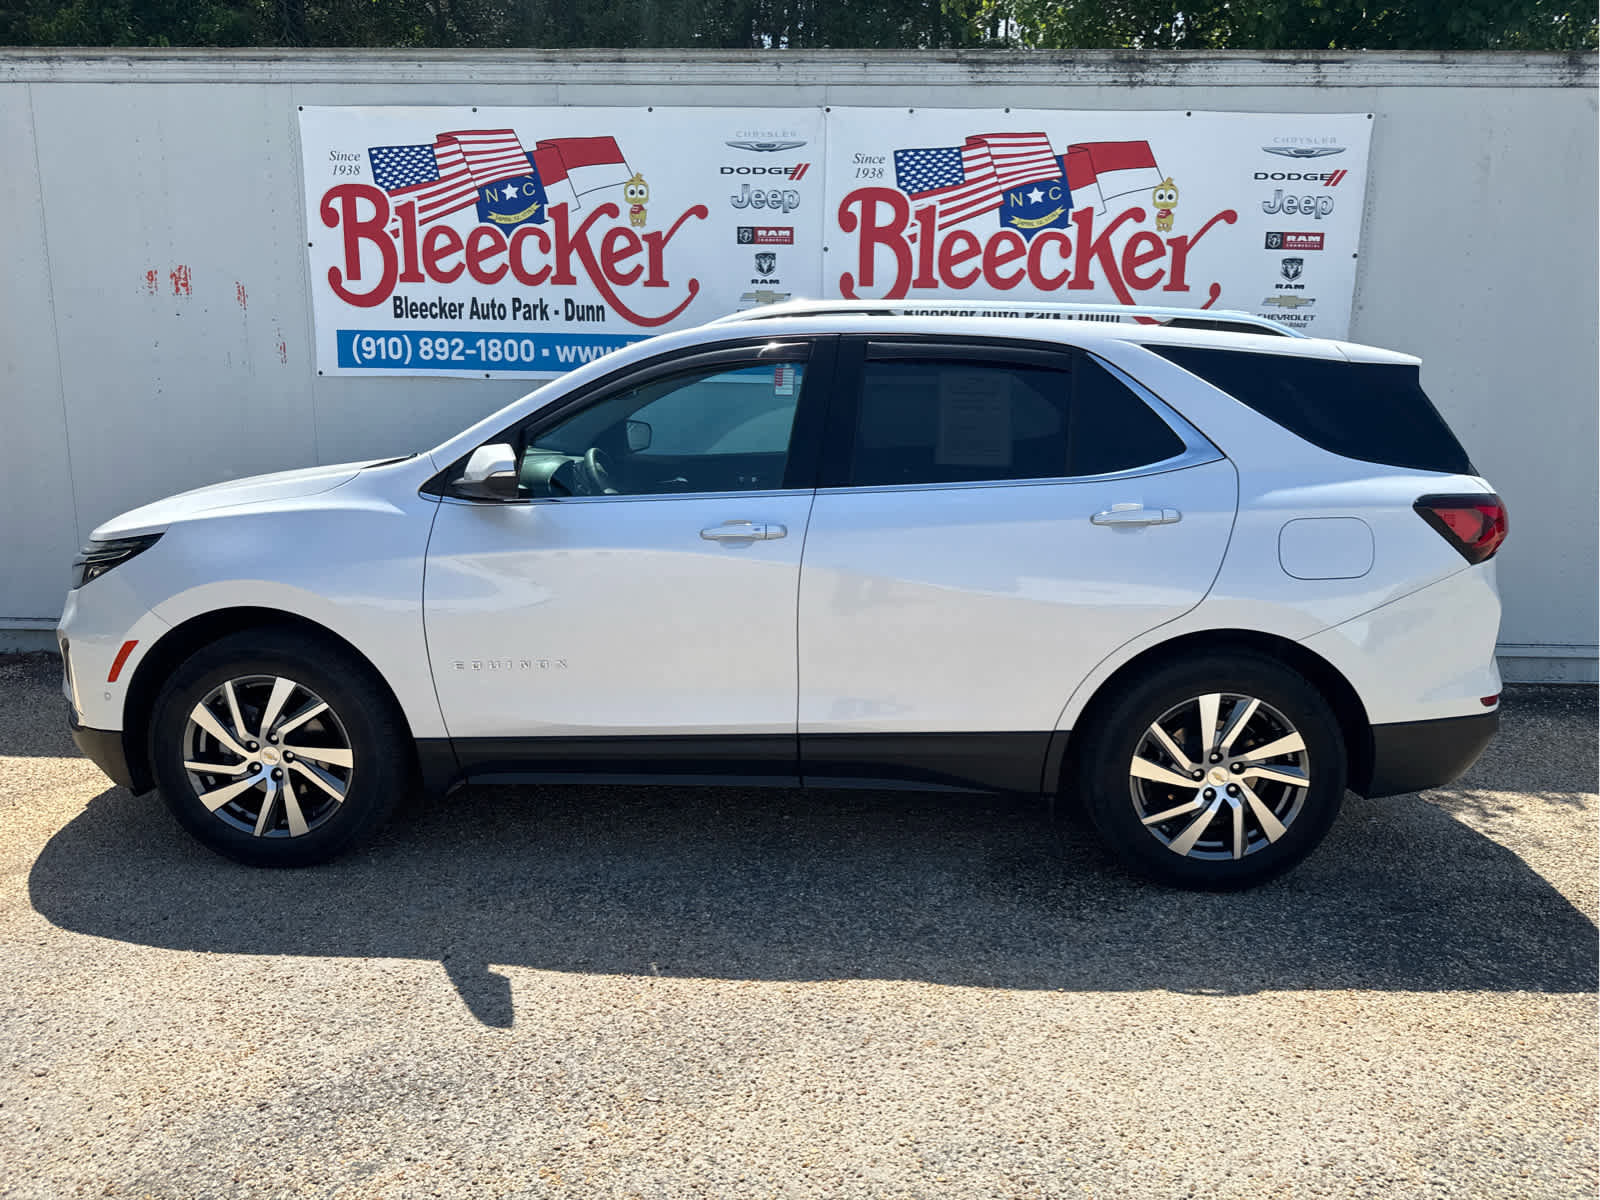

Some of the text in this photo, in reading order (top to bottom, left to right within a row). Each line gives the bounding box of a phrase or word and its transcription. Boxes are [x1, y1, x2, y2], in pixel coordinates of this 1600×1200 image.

[329, 150, 361, 162] Since
[852, 153, 886, 165] Since
[332, 165, 361, 176] 1938
[720, 166, 797, 175] DODGE
[855, 167, 884, 179] 1938
[1253, 172, 1334, 181] DODGE
[485, 182, 536, 203] N C
[730, 183, 800, 213] Jeep
[1010, 186, 1062, 208] N C
[1262, 189, 1334, 219] Jeep
[320, 183, 708, 327] Bleecker
[837, 187, 1238, 324] Bleecker
[392, 296, 606, 322] Bleecker Auto Park Dunn
[352, 334, 412, 364] (910)
[419, 337, 535, 362] 892-1800
[452, 659, 568, 671] EQUINOX
